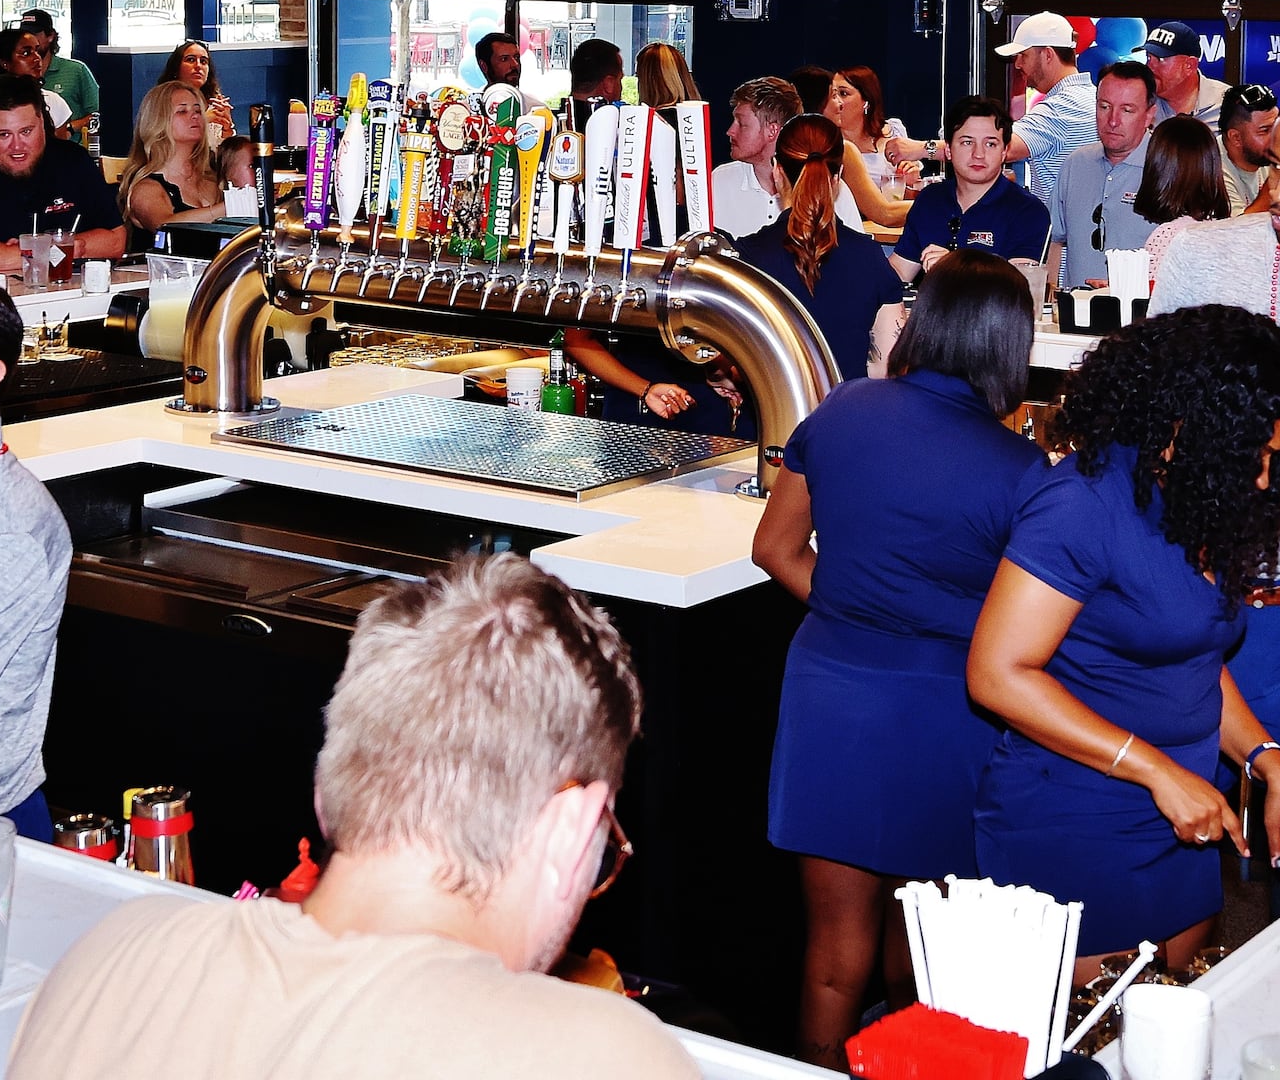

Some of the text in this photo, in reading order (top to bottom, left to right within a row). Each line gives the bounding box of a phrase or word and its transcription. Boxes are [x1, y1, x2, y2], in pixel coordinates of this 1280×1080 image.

[311, 127, 328, 209] PURPLE HAZE
[371, 124, 384, 193] SUMMER ALE
[409, 133, 429, 150] IPA
[623, 115, 636, 168] ULTRA
[686, 115, 696, 166] ULTRA
[406, 160, 421, 230] VOODOO RANGER
